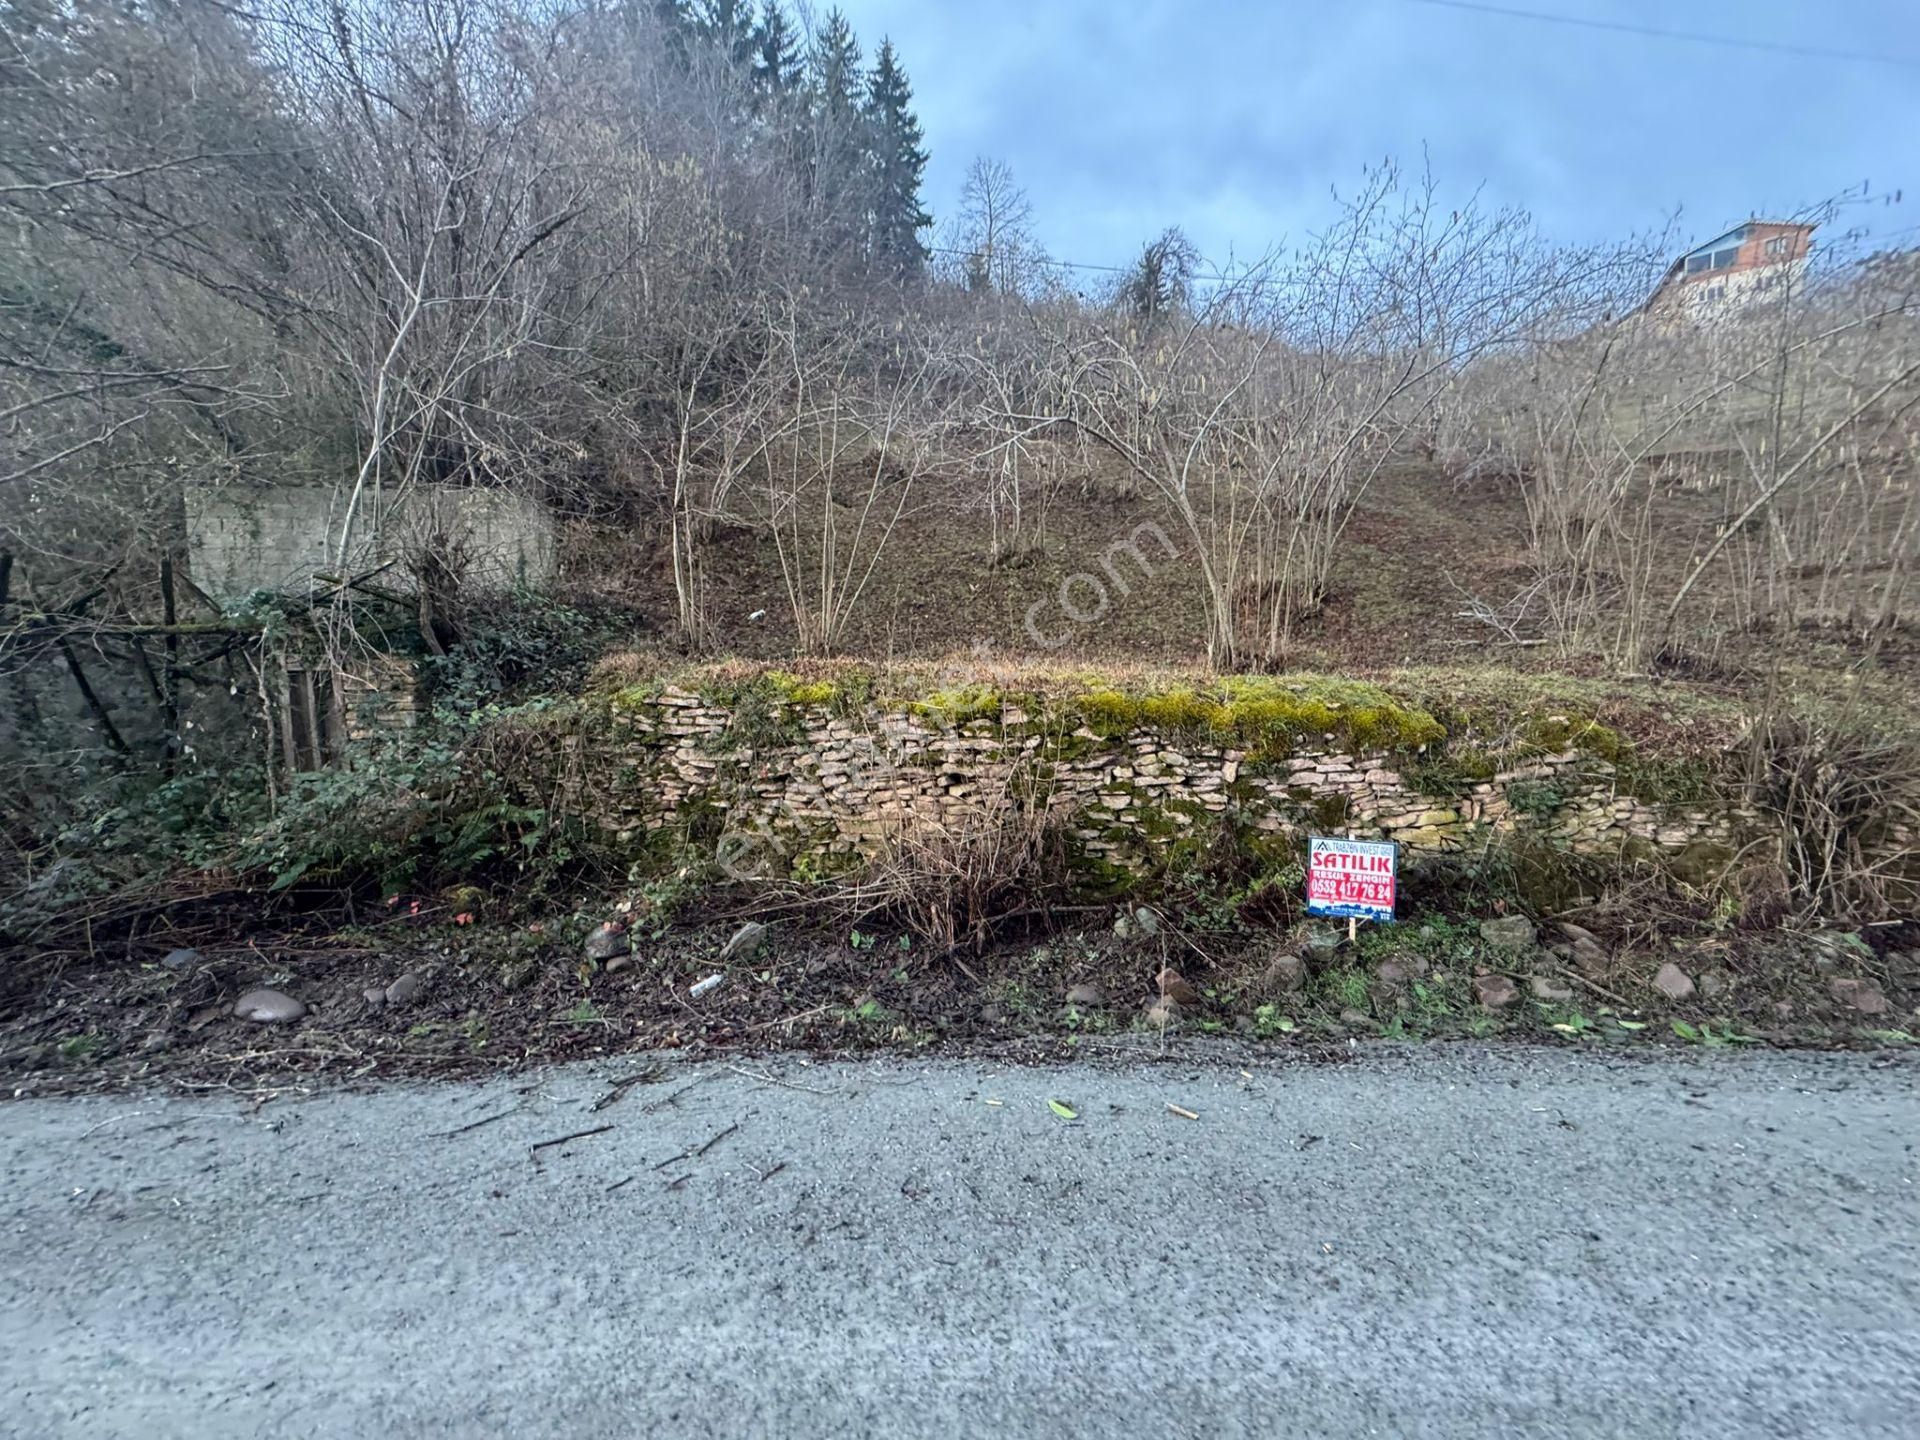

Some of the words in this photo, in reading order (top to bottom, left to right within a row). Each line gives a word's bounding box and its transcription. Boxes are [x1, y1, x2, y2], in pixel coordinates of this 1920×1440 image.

[1313, 852, 1391, 873] SATILIK
[1339, 881, 1359, 896] 417
[1361, 883, 1375, 898] 76
[1378, 885, 1391, 900] 24
